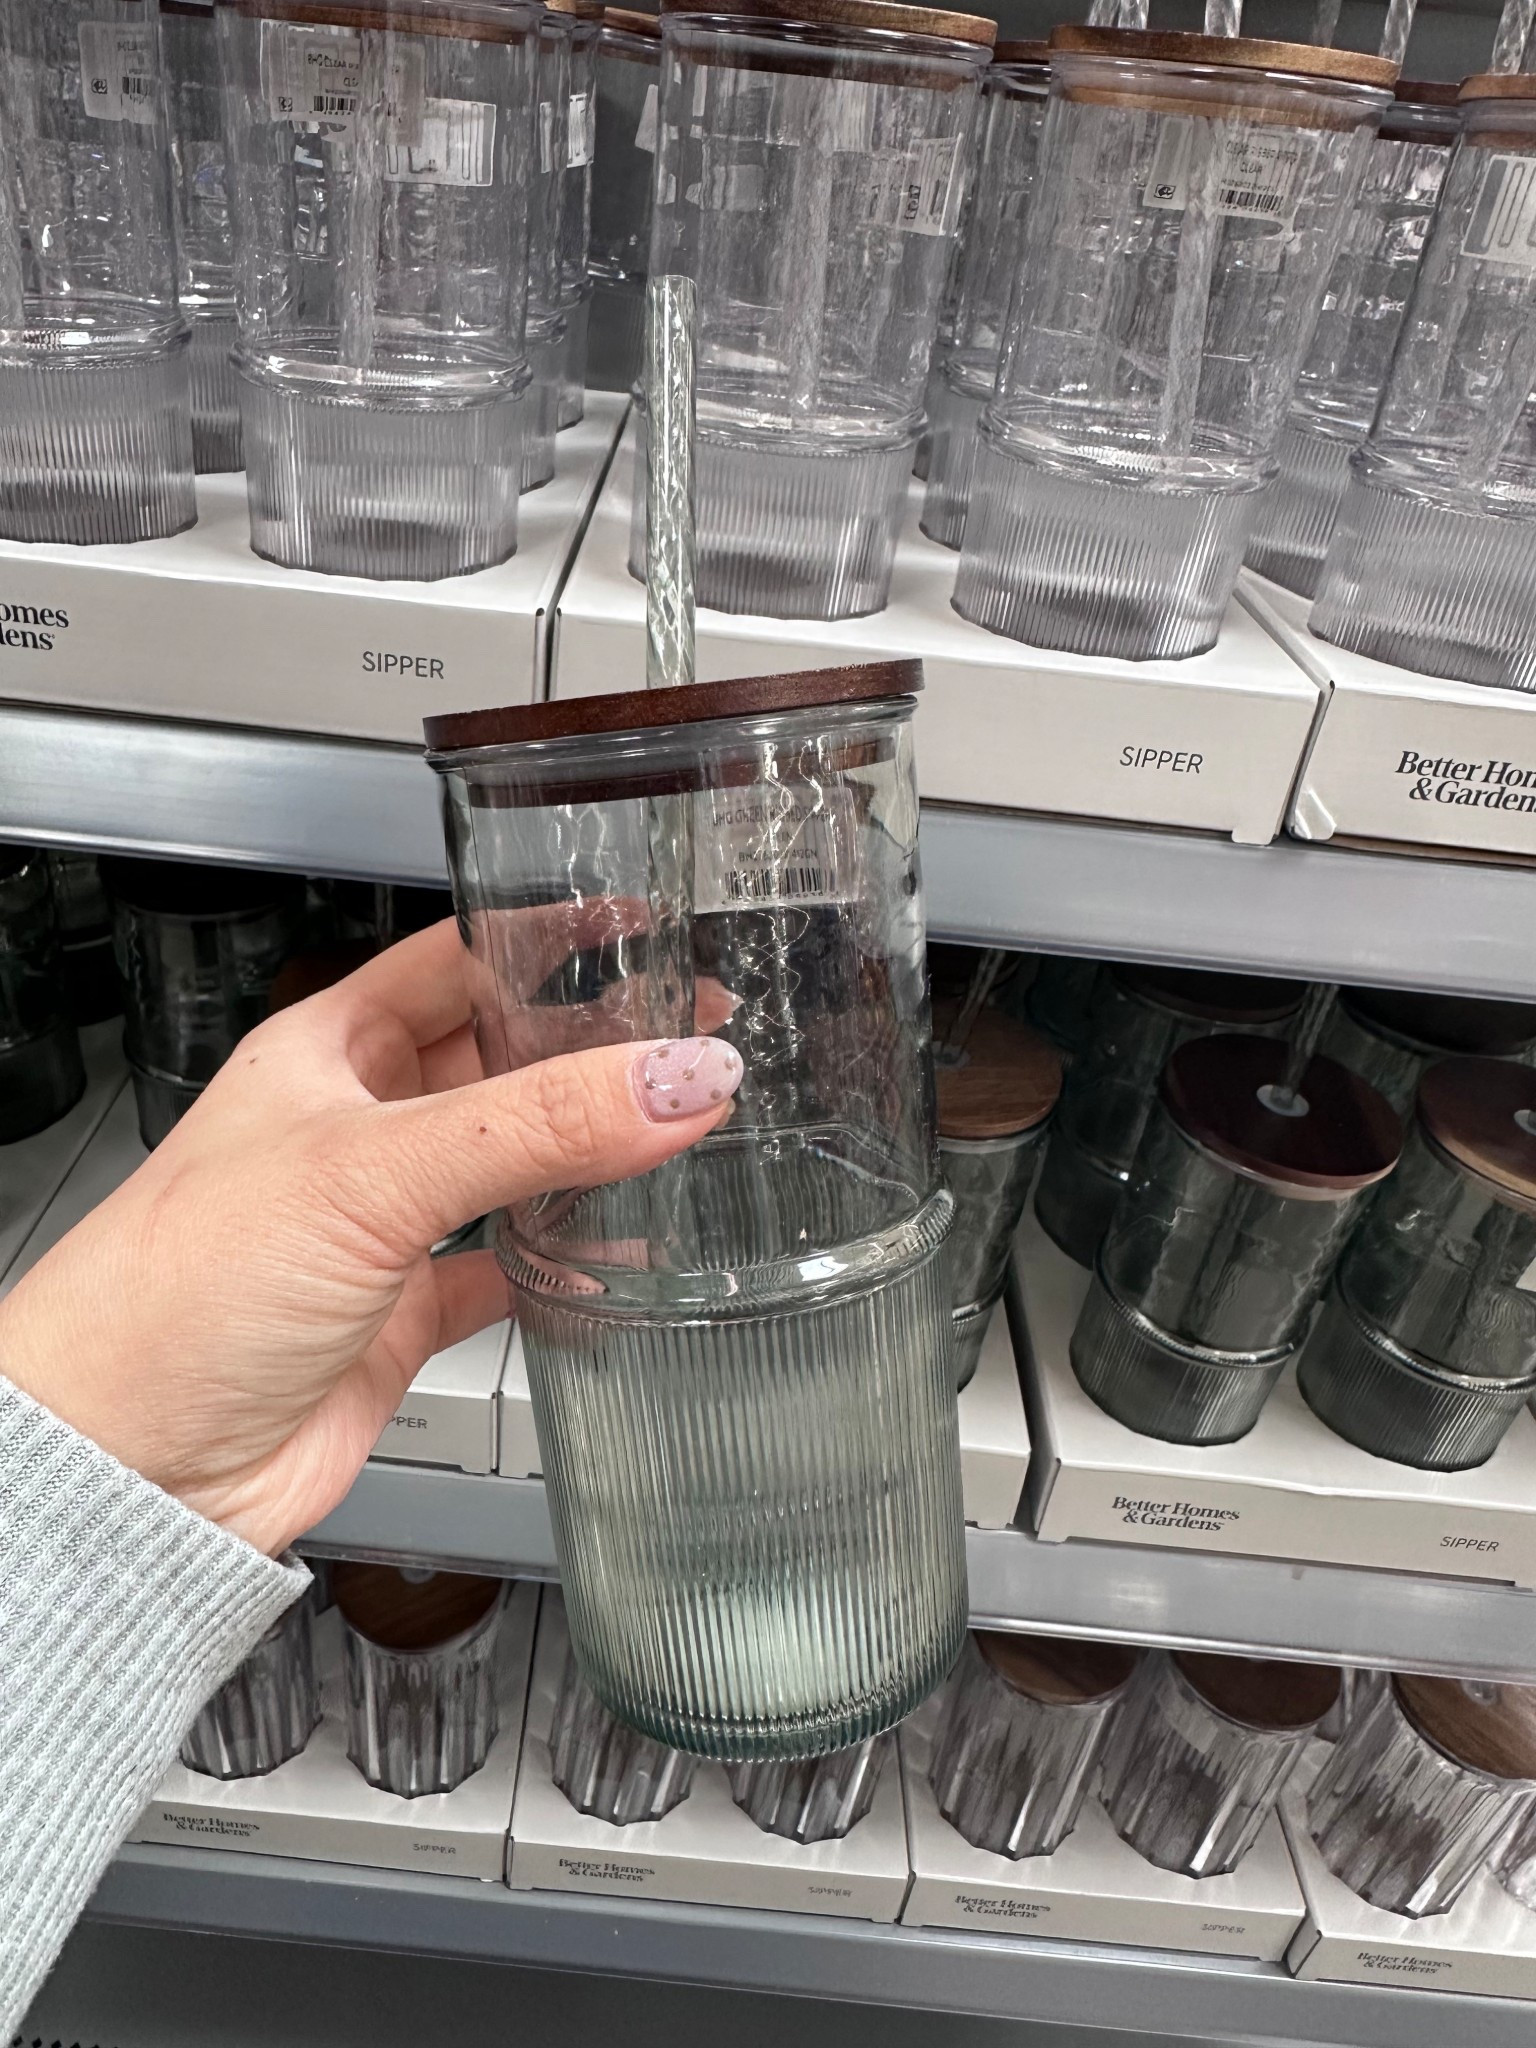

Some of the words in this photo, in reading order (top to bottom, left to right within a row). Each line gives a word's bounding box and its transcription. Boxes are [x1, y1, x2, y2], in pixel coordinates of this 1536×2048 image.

[362, 651, 445, 680] SIPPER
[1119, 745, 1204, 775] SIPPER
[1395, 750, 1483, 782] Better
[1112, 1496, 1172, 1514] Better
[1171, 1502, 1240, 1521] Homes
[1439, 1536, 1500, 1552] SIPPER
